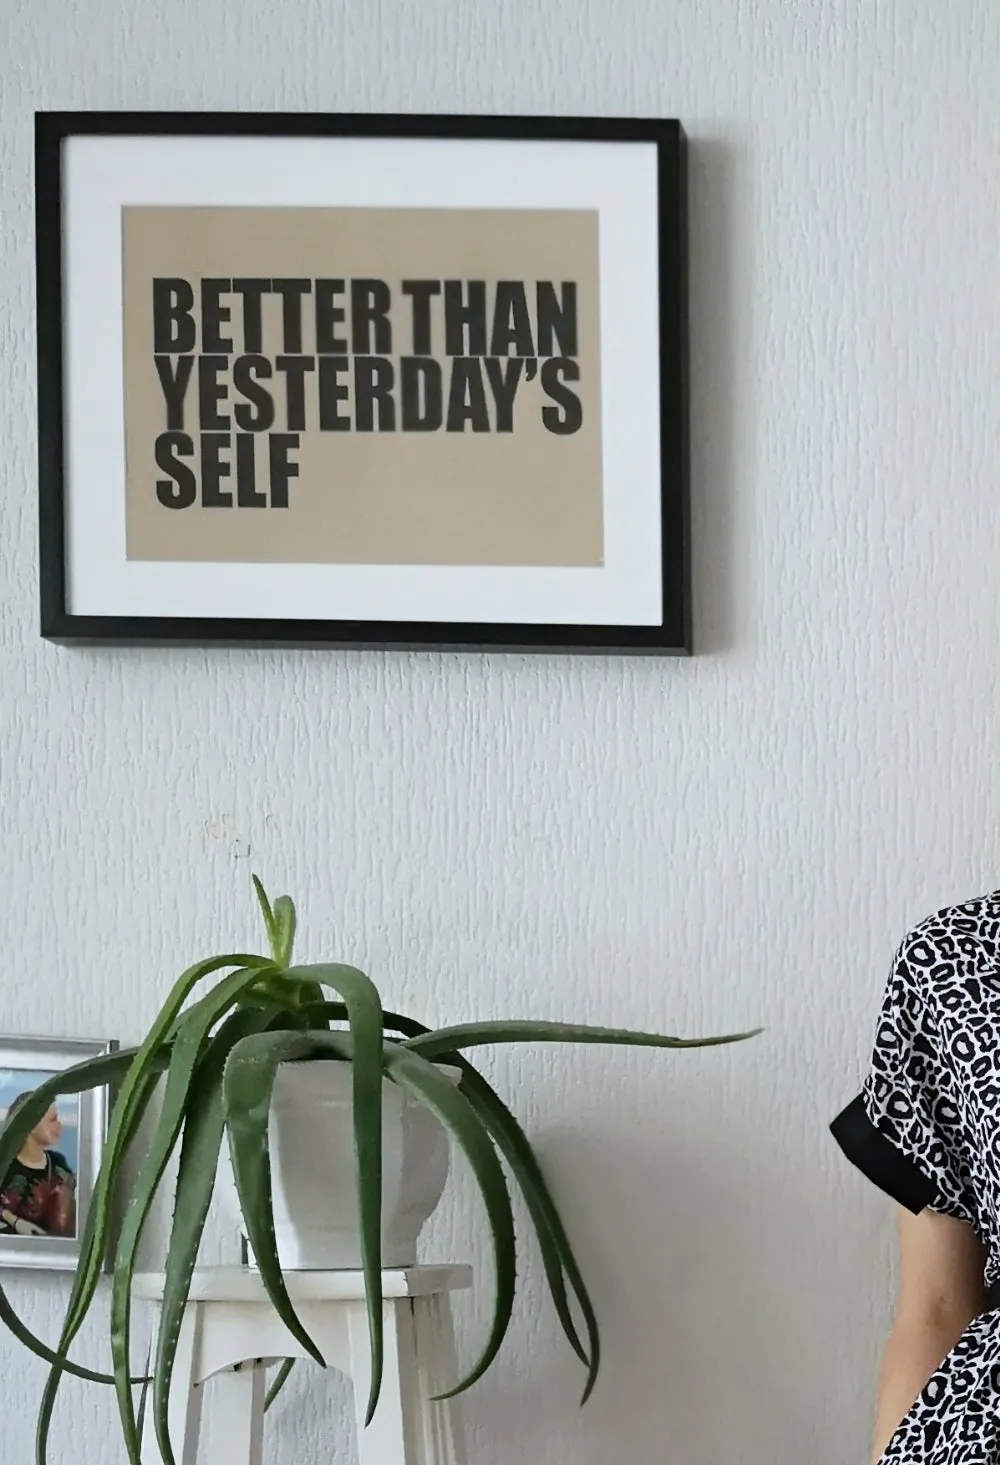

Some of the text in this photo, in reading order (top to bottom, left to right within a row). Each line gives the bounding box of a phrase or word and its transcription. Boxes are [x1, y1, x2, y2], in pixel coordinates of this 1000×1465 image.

[152, 277, 578, 357] BETTER THAN
[153, 354, 583, 435] YESTERDAY'S
[154, 431, 300, 510] SELF
